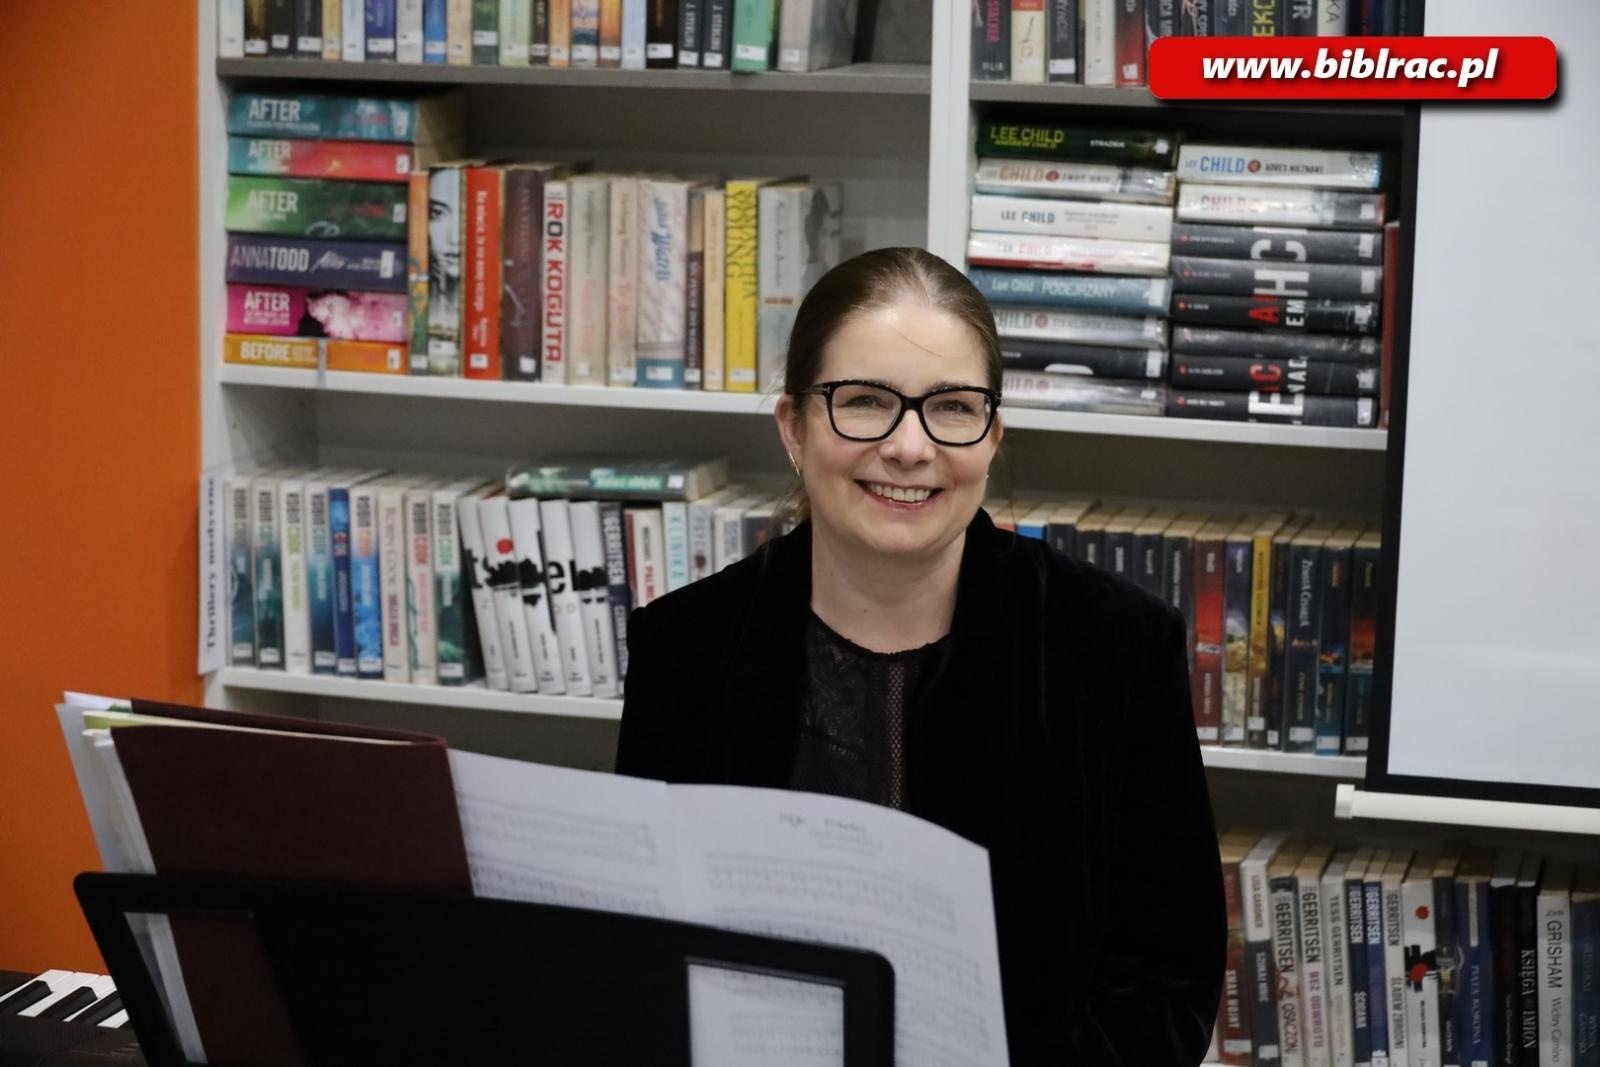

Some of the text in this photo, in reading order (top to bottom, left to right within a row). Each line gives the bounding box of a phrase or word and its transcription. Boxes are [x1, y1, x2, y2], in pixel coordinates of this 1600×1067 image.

[248, 98, 301, 122] AFTER
[991, 126, 1065, 143] LEE CHILD
[248, 139, 292, 160] AFTER
[1199, 155, 1246, 174] CHILD
[247, 189, 299, 213] AFTER
[1001, 210, 1016, 221] LEE
[1021, 210, 1055, 224] CHILD
[726, 189, 744, 278] YOUNG
[244, 290, 290, 312] AFTER
[545, 202, 564, 363] ROK KOGUTA
[240, 342, 290, 362] BEFORE
[604, 515, 626, 586] GERRITSEN
[668, 515, 686, 579] KLINIKA
[1330, 895, 1340, 923] TESS
[1349, 890, 1364, 944] GERRITSEN
[1365, 891, 1382, 945] GERRITSEN
[1387, 893, 1400, 947] GERRITSEN
[1275, 903, 1295, 974] GERRITSEN
[1332, 926, 1344, 987] GERRITSEN
[1546, 920, 1563, 989] GRISHAM
[1301, 892, 1324, 1048] GERRITSEN BEZ ODWROTU
[1518, 949, 1537, 1049] KSIĘGA IMION
